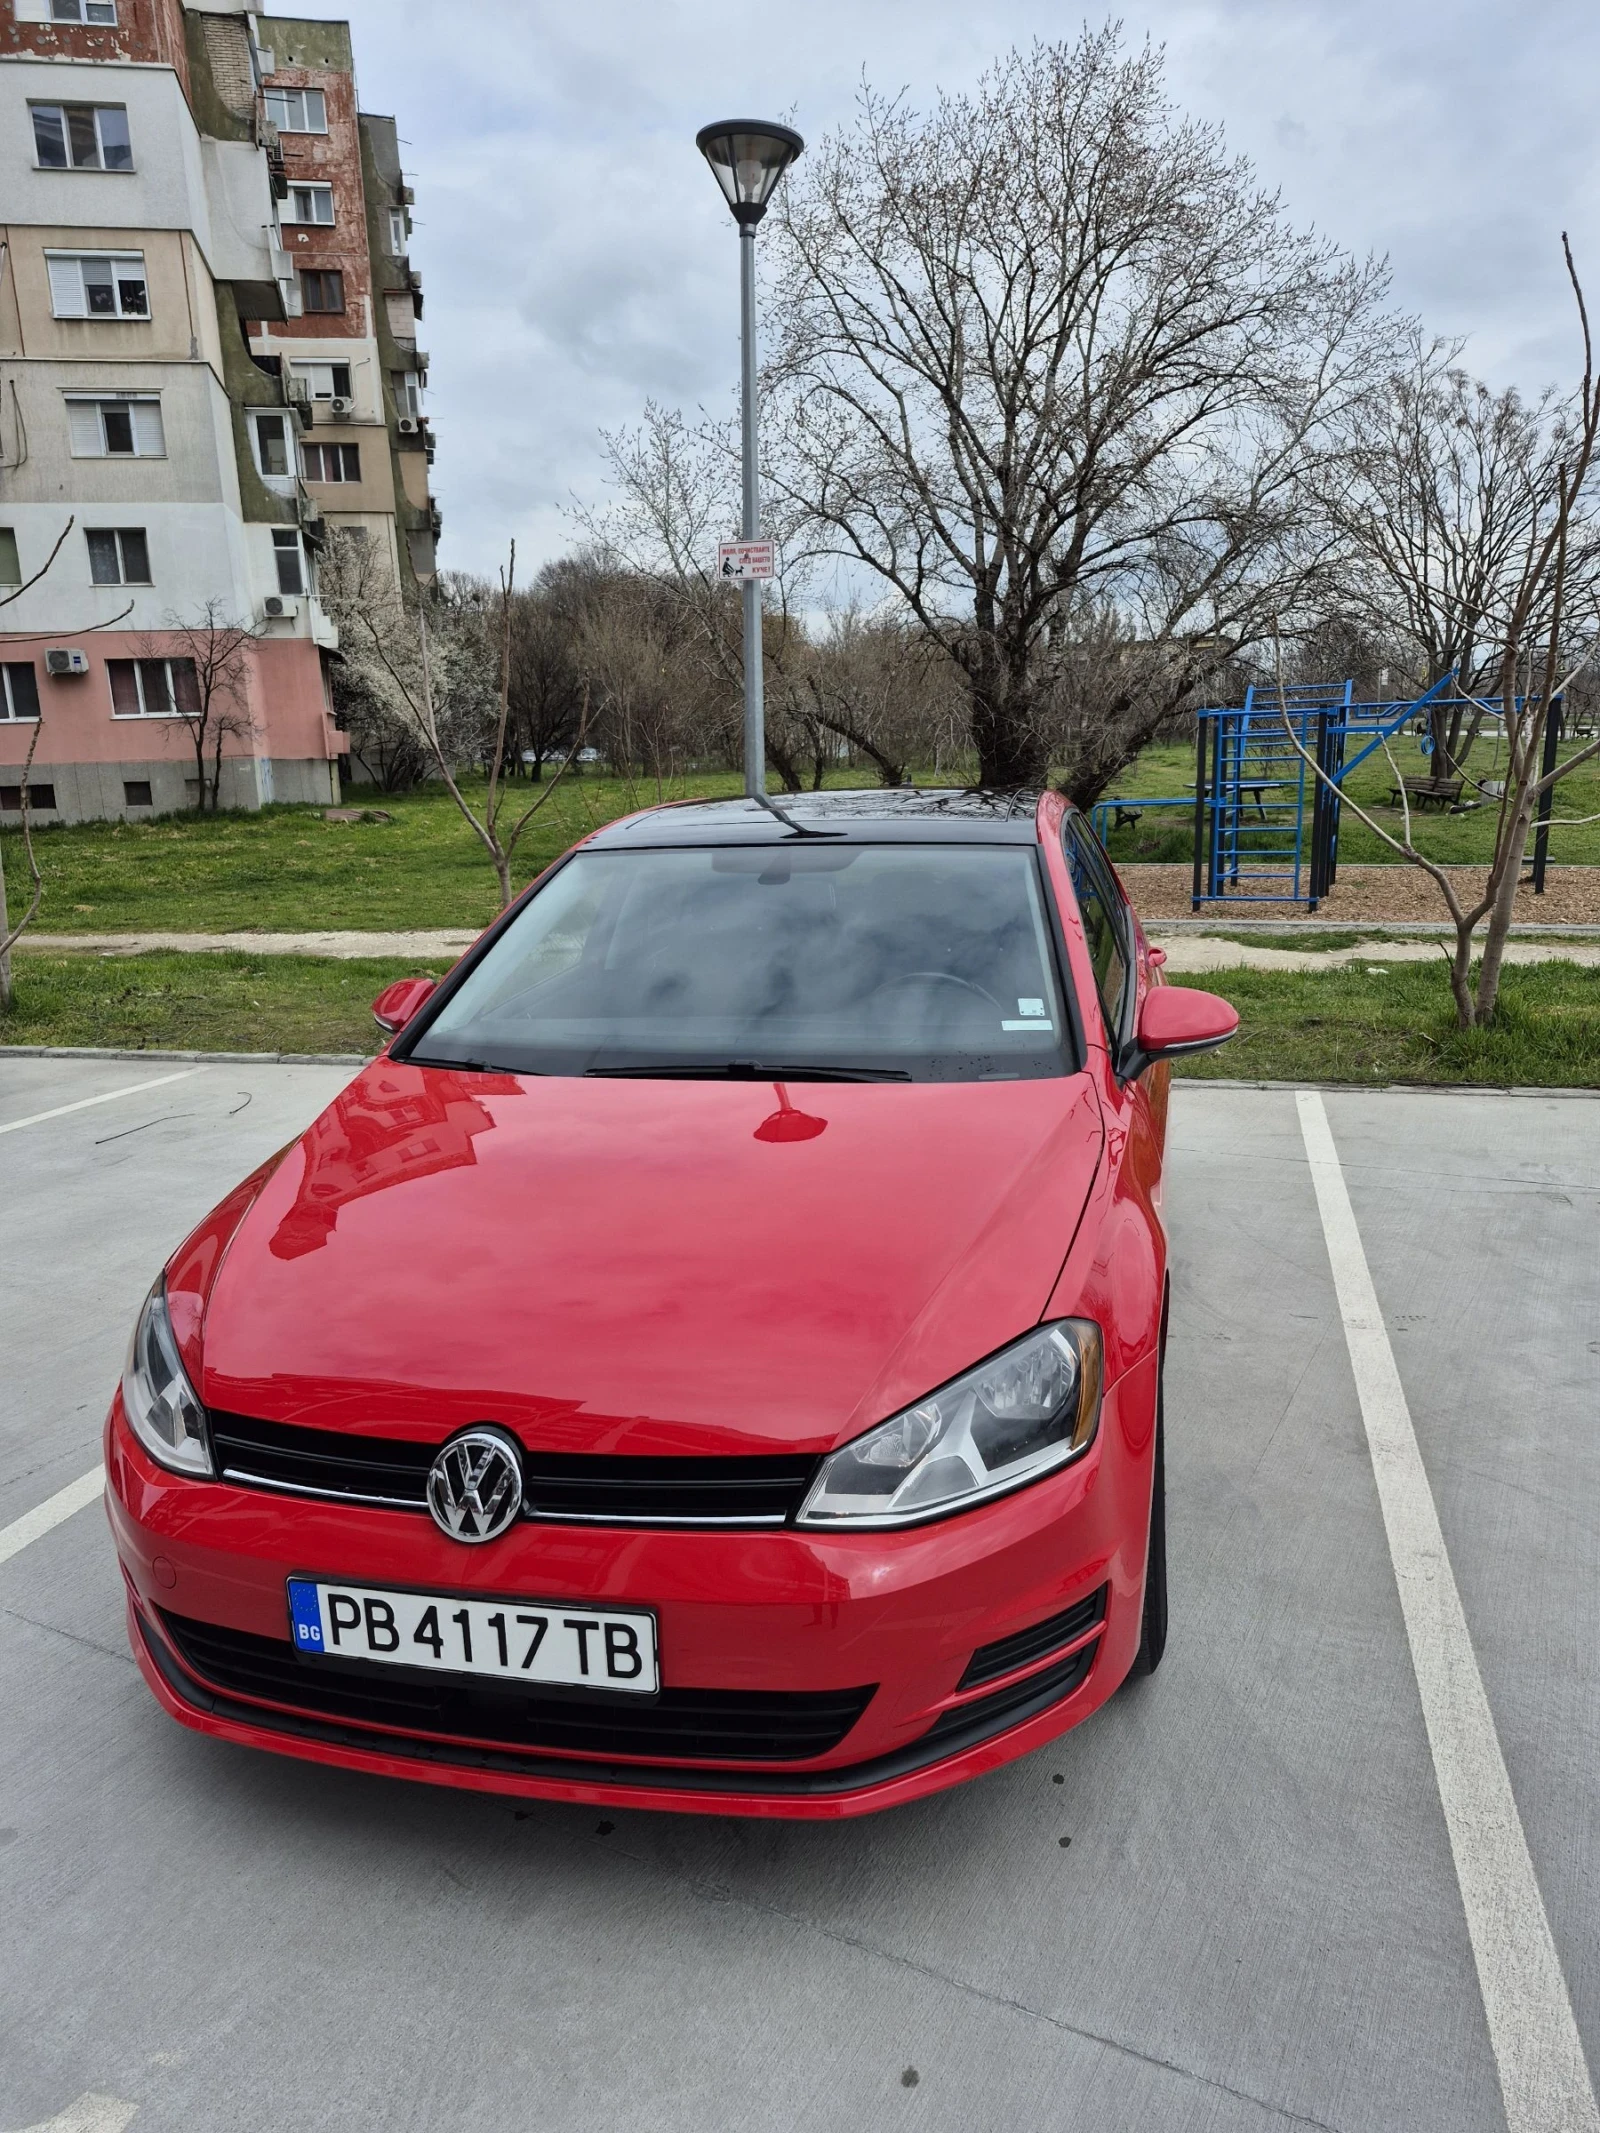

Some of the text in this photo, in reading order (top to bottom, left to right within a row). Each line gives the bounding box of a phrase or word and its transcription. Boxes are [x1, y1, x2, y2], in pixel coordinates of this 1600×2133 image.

[298, 1623, 321, 1641] BG
[327, 1593, 643, 1679] PB 4117 TB
